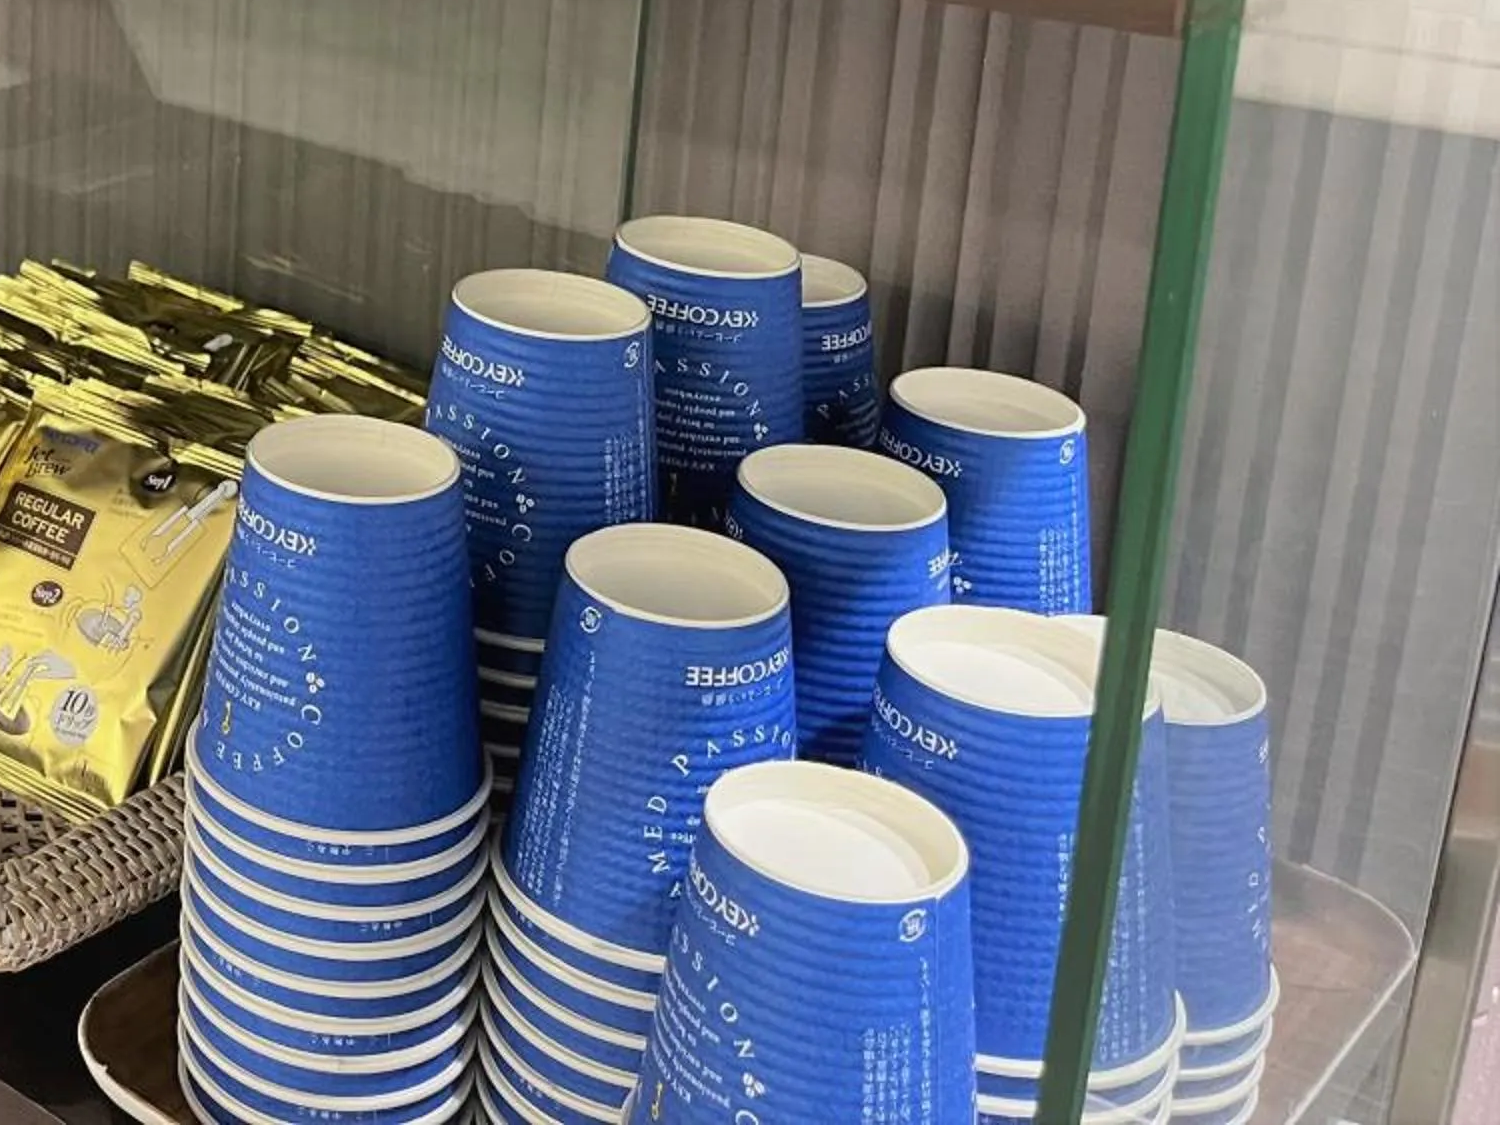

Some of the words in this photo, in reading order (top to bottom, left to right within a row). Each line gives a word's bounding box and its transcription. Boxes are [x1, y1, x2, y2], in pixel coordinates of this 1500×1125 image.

[653, 357, 762, 418] ASSION
[9, 508, 69, 546] COFFEE
[13, 489, 87, 533] REGULAR
